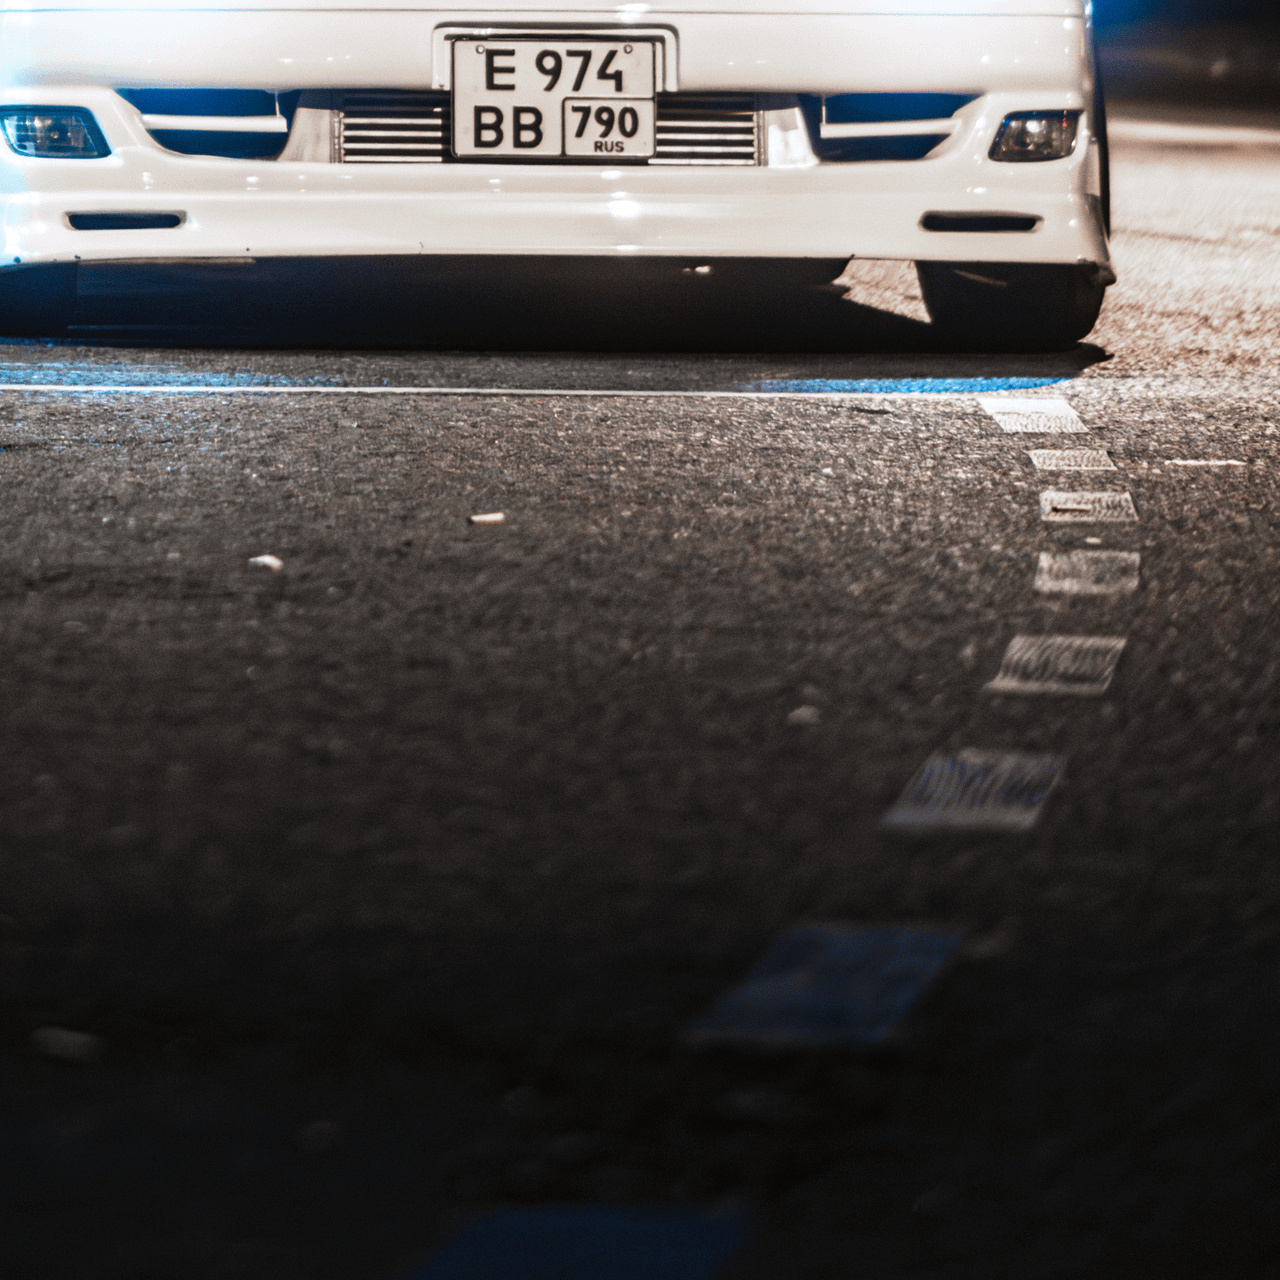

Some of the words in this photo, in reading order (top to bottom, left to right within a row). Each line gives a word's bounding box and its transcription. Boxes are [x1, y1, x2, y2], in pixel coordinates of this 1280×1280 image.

[485, 48, 515, 91] E
[535, 49, 623, 92] 974
[474, 105, 543, 149] BB
[571, 105, 639, 138] 790
[594, 141, 625, 153] RUS
